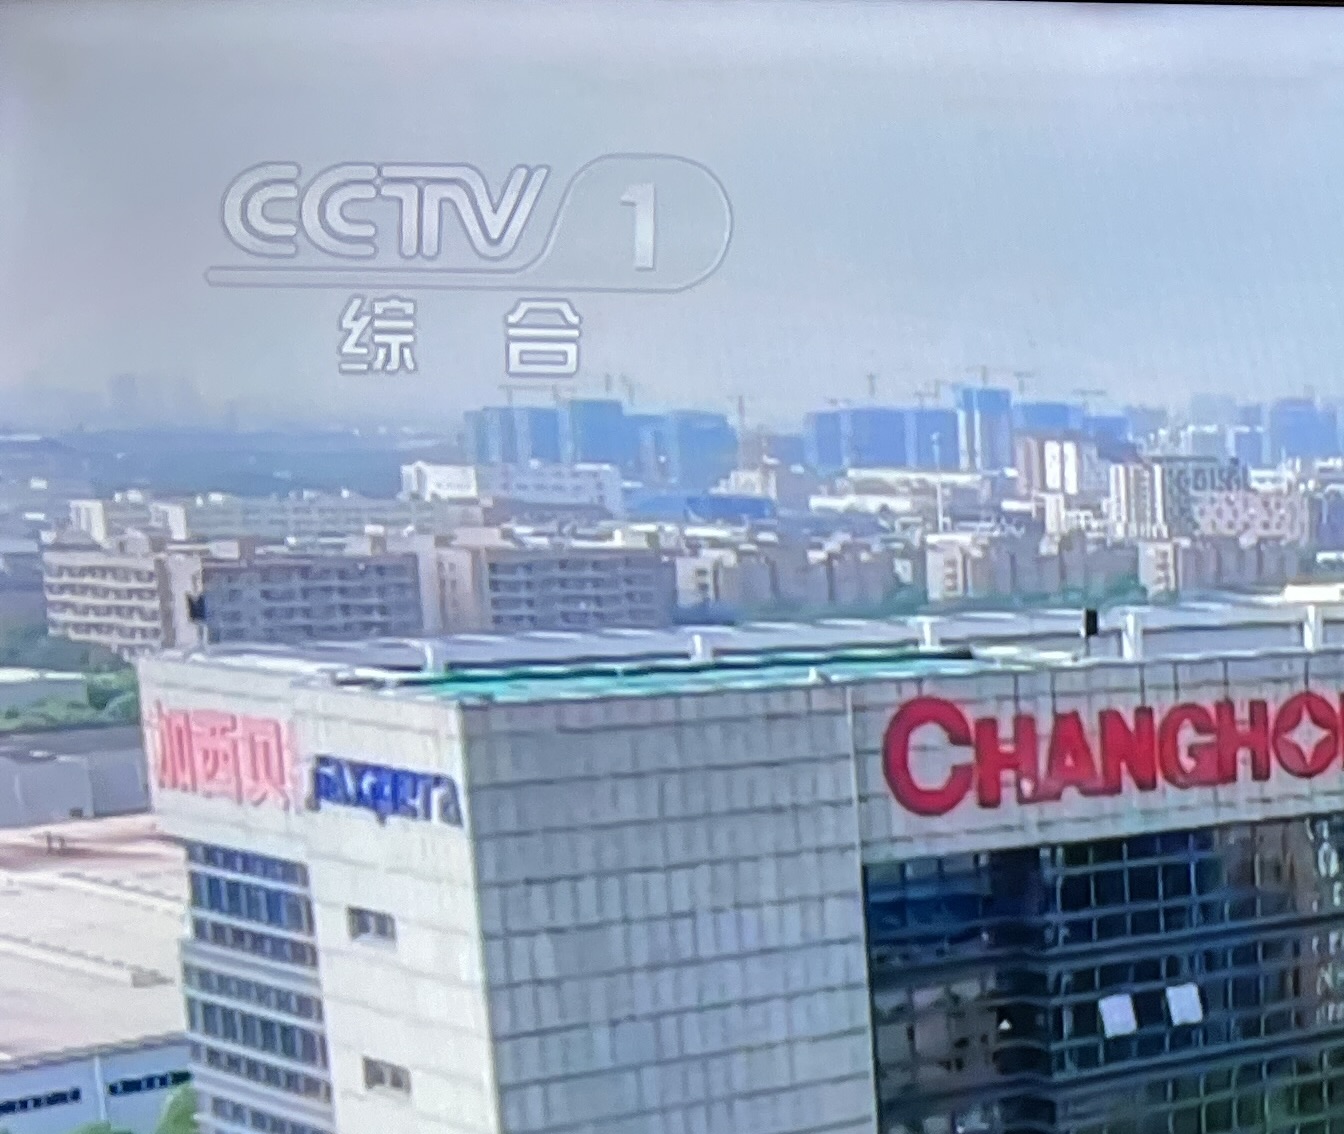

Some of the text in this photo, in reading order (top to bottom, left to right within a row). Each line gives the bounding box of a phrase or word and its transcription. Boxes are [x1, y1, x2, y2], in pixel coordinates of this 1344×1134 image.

[220, 160, 657, 272] CCTV 1
[337, 296, 583, 377] 综合
